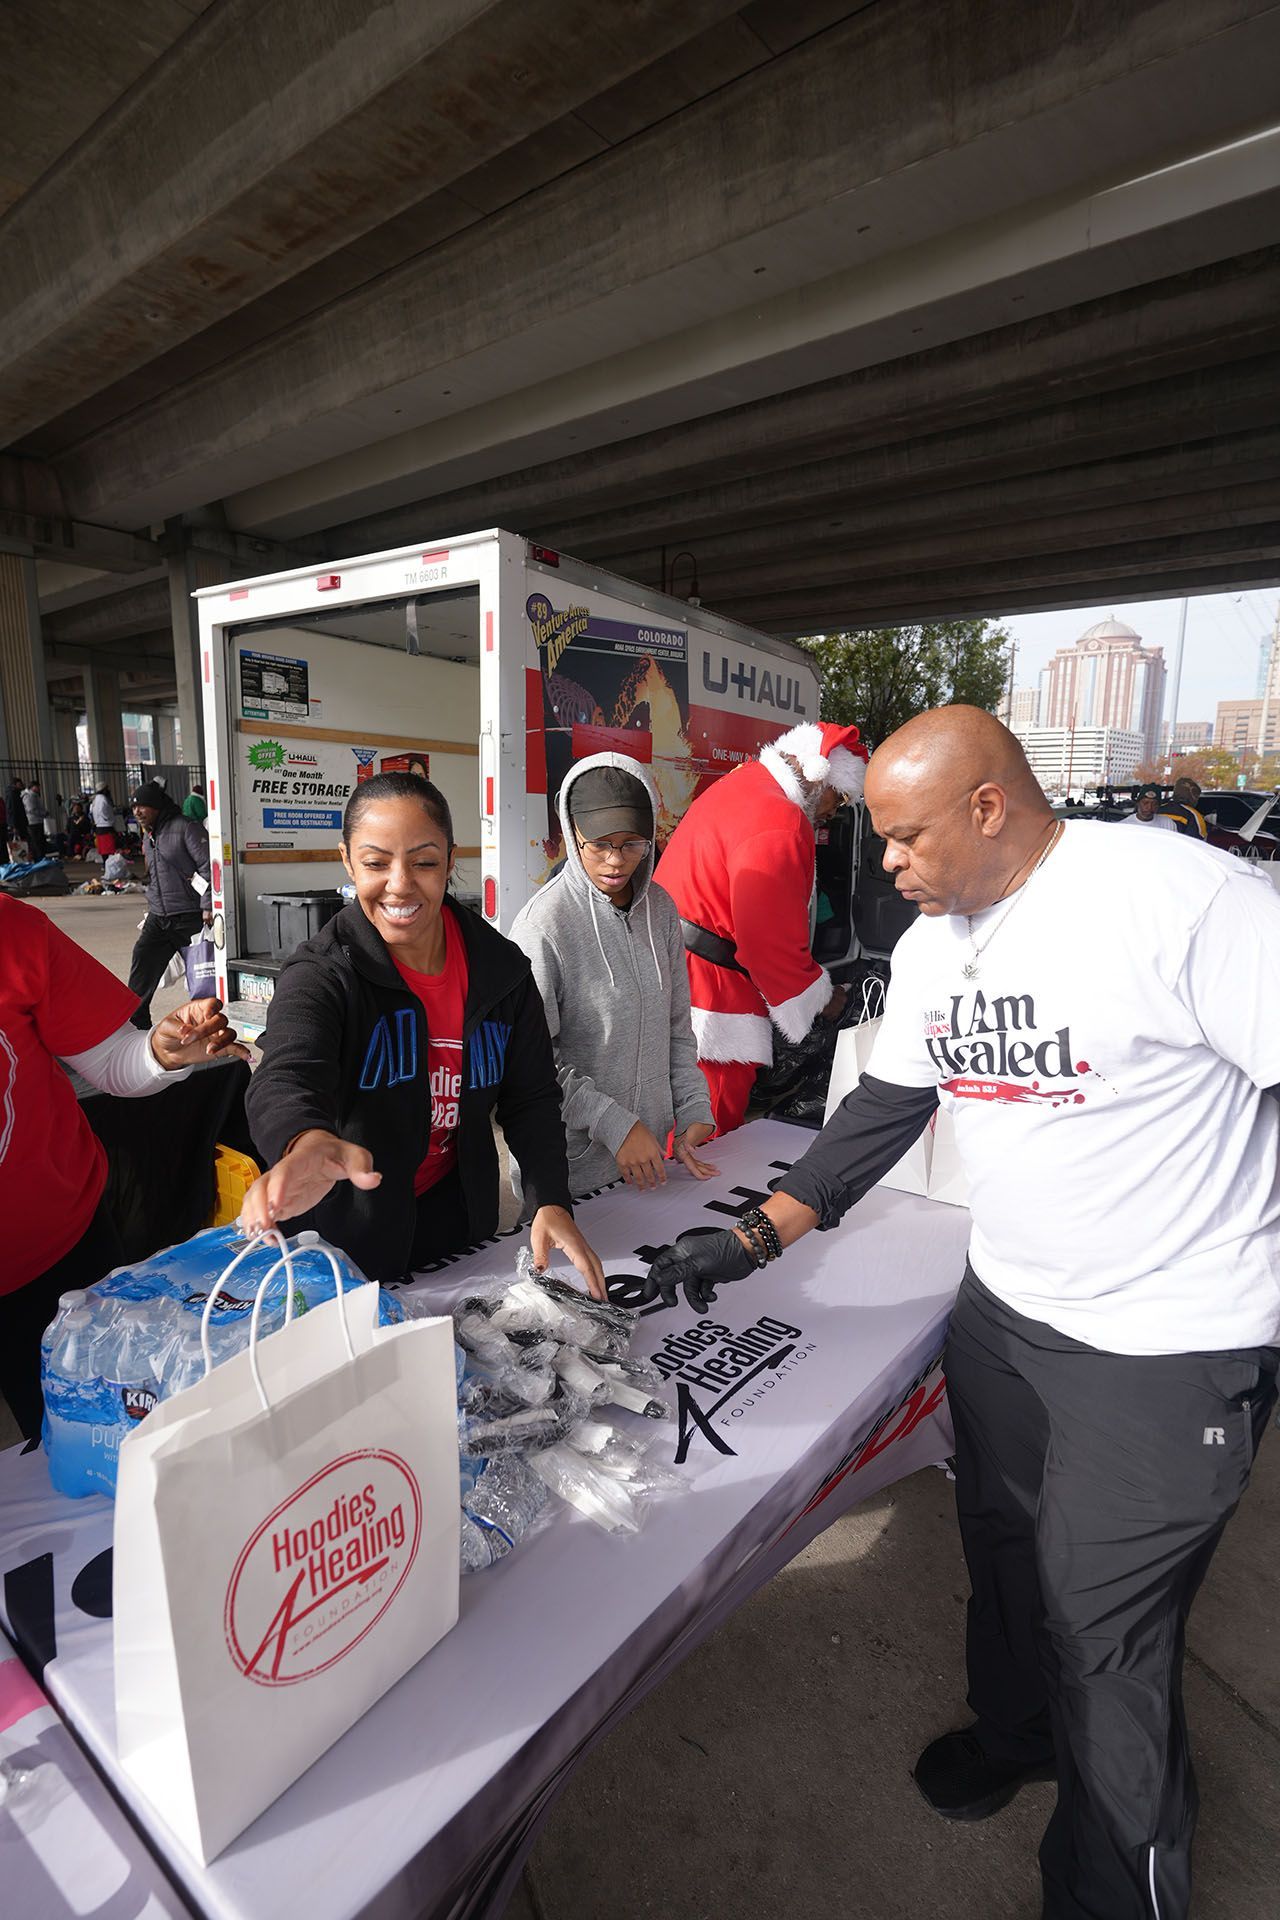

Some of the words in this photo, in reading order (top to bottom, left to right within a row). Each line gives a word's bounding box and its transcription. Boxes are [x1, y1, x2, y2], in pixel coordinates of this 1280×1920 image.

[404, 572, 417, 585] TM
[441, 566, 448, 579] R
[531, 602, 548, 620] #89
[531, 609, 569, 649] Venture
[547, 618, 588, 680] America
[637, 629, 684, 647] COLORADO
[282, 769, 298, 778] One
[712, 748, 744, 762] ONE-WAY
[252, 780, 288, 795] FREE
[292, 782, 350, 798] STORAGE
[950, 995, 963, 1040] I
[965, 990, 1037, 1037] Am
[649, 1320, 731, 1382] odies
[676, 1316, 803, 1395] Healing
[720, 1343, 817, 1427] FOUNDATION
[1202, 1427, 1226, 1445] R
[272, 1484, 377, 1573] Hoodies
[308, 1504, 405, 1598] Healing
[293, 1560, 399, 1644] FOUNDATION
